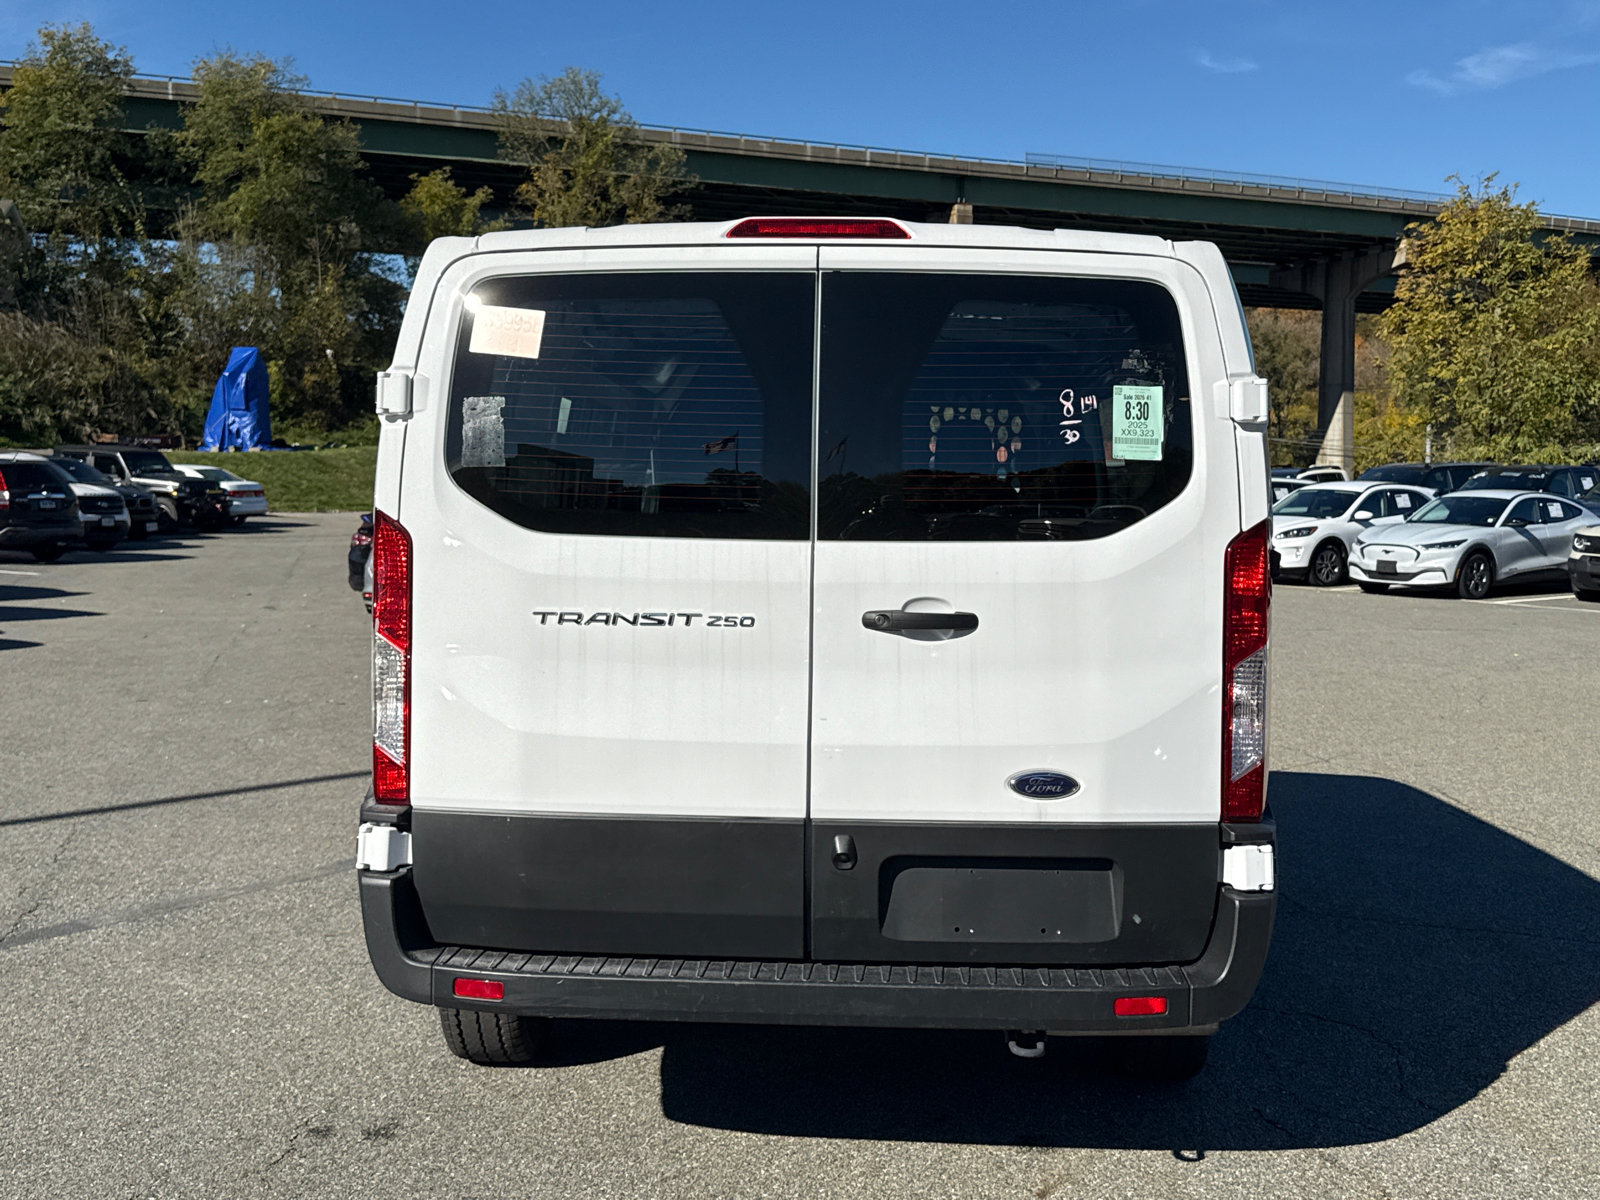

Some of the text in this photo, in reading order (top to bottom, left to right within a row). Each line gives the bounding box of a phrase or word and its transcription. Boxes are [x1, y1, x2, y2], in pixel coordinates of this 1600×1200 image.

[1060, 389, 1074, 417] 8
[1125, 401, 1149, 421] 8:30
[1127, 421, 1148, 429] 2025
[1060, 429, 1080, 445] 30
[532, 611, 756, 628] TRANSIT 250
[1025, 777, 1064, 793] Ford
